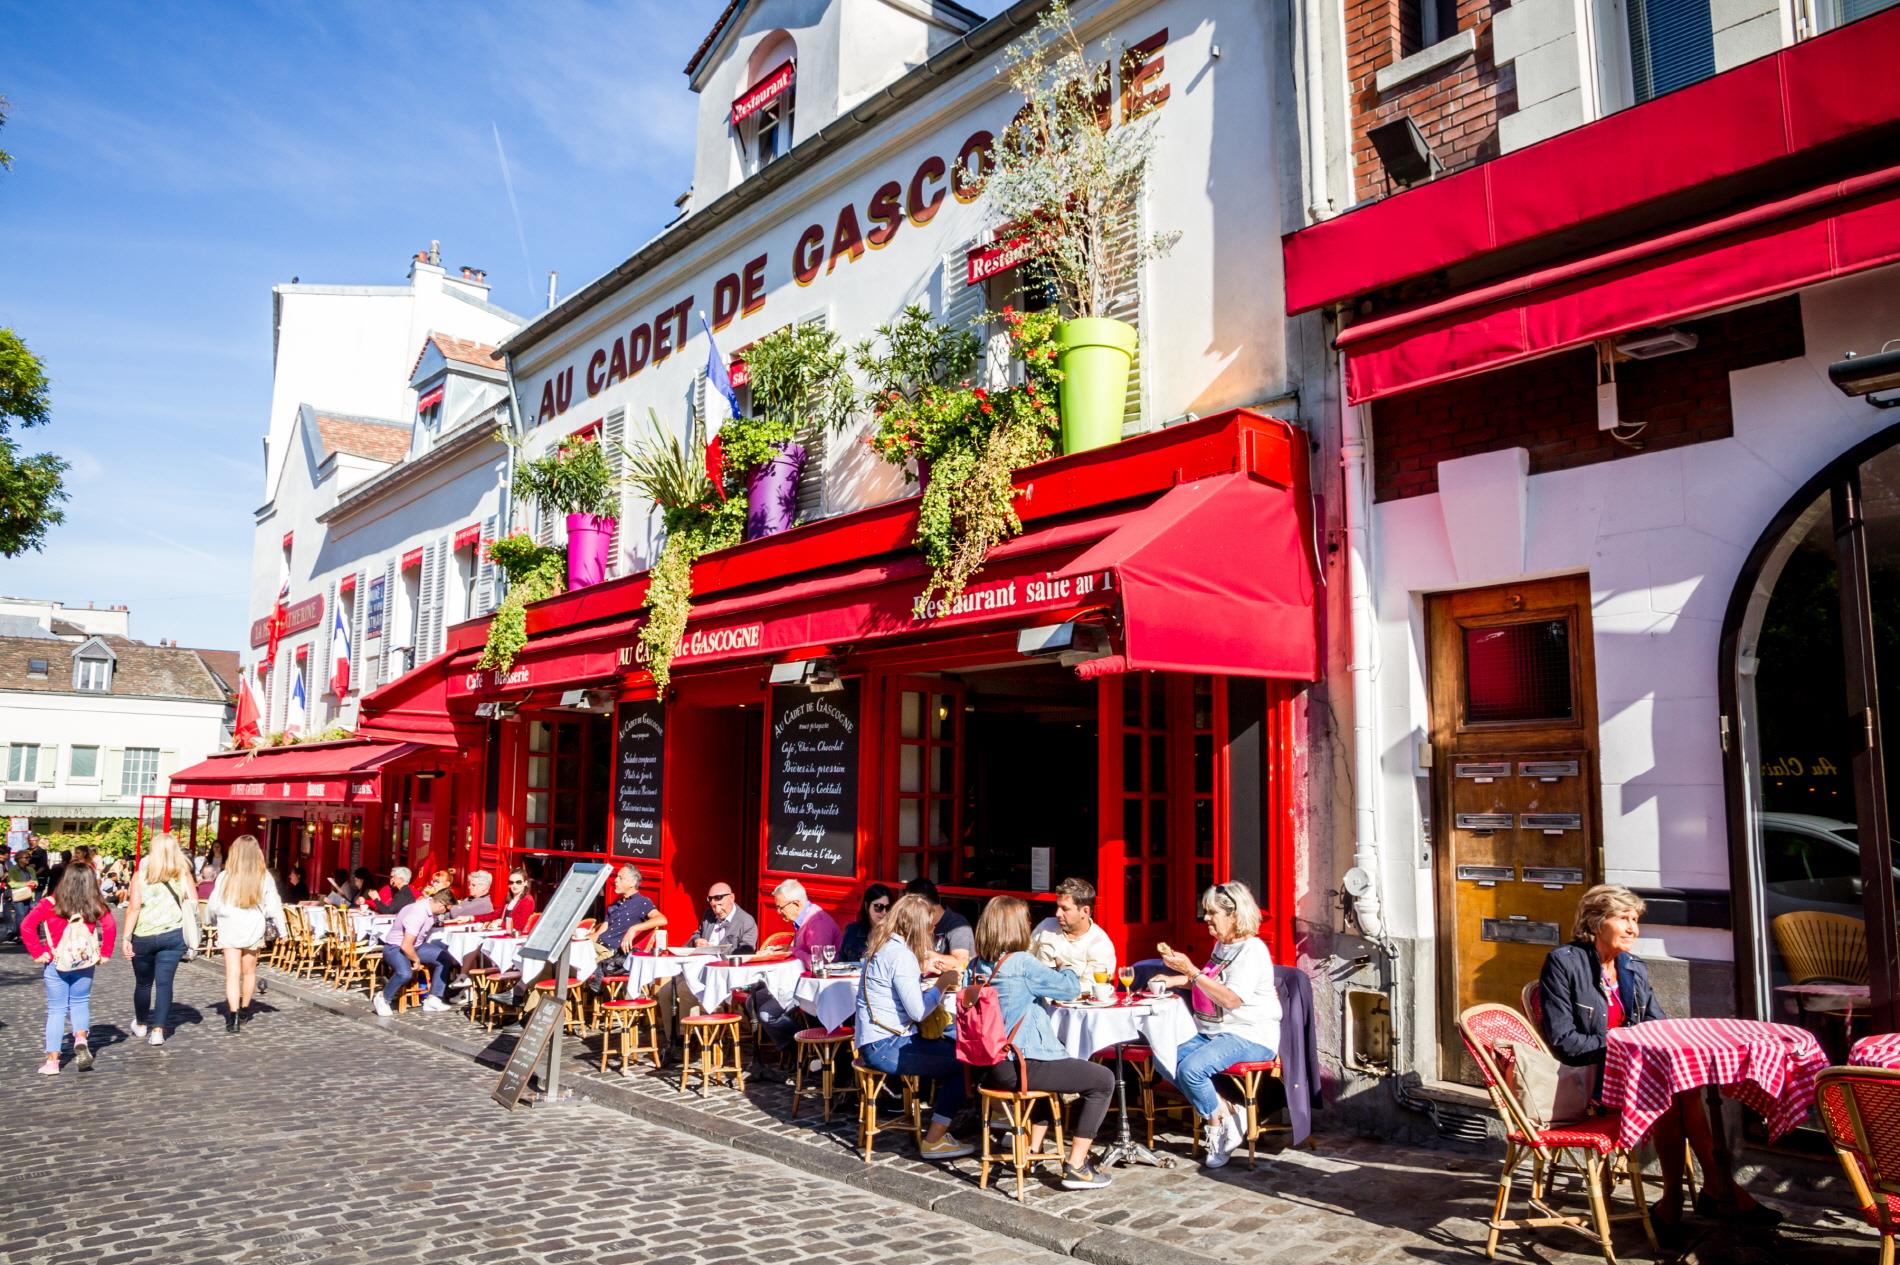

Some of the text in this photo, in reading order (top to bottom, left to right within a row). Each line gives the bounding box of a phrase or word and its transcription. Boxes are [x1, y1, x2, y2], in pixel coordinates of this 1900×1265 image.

[735, 73, 788, 121] Restaurant
[537, 366, 573, 425] AU
[586, 295, 694, 399] CADET
[713, 253, 767, 333] DE
[912, 580, 1016, 621] Restaurant
[1076, 574, 1095, 595] au
[618, 646, 633, 665] AU
[675, 639, 690, 658] de
[691, 628, 760, 656] GASCOGNE
[466, 665, 529, 690] Café Brasserie
[784, 704, 804, 724] CADET
[816, 696, 853, 734] GASCOGNE
[817, 739, 844, 752] Chocolat
[816, 763, 845, 778] pression
[795, 821, 826, 844] Digestifs
